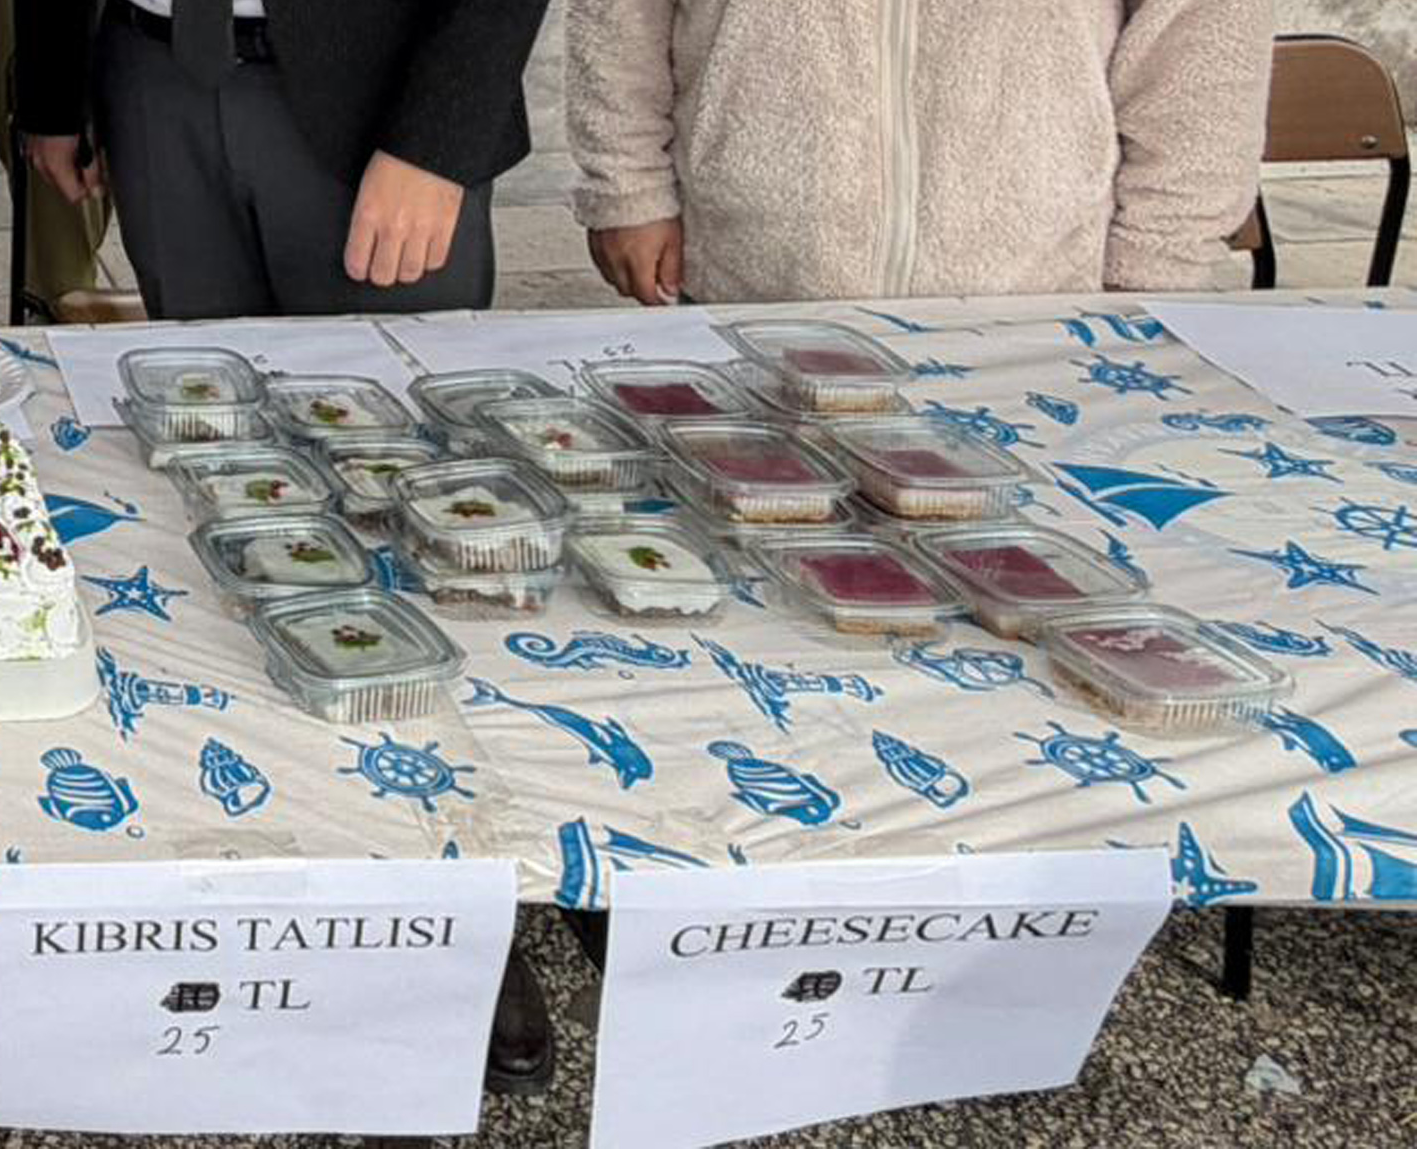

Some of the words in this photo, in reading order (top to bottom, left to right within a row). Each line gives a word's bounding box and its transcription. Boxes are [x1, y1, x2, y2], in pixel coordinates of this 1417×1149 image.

[32, 919, 219, 955] KIBRIS
[236, 916, 456, 951] TATLISI
[670, 910, 1099, 958] CHEESECAKE
[239, 978, 311, 1011] TL
[862, 966, 934, 995] TL
[156, 1025, 221, 1056] 25
[773, 1012, 830, 1049] 25
